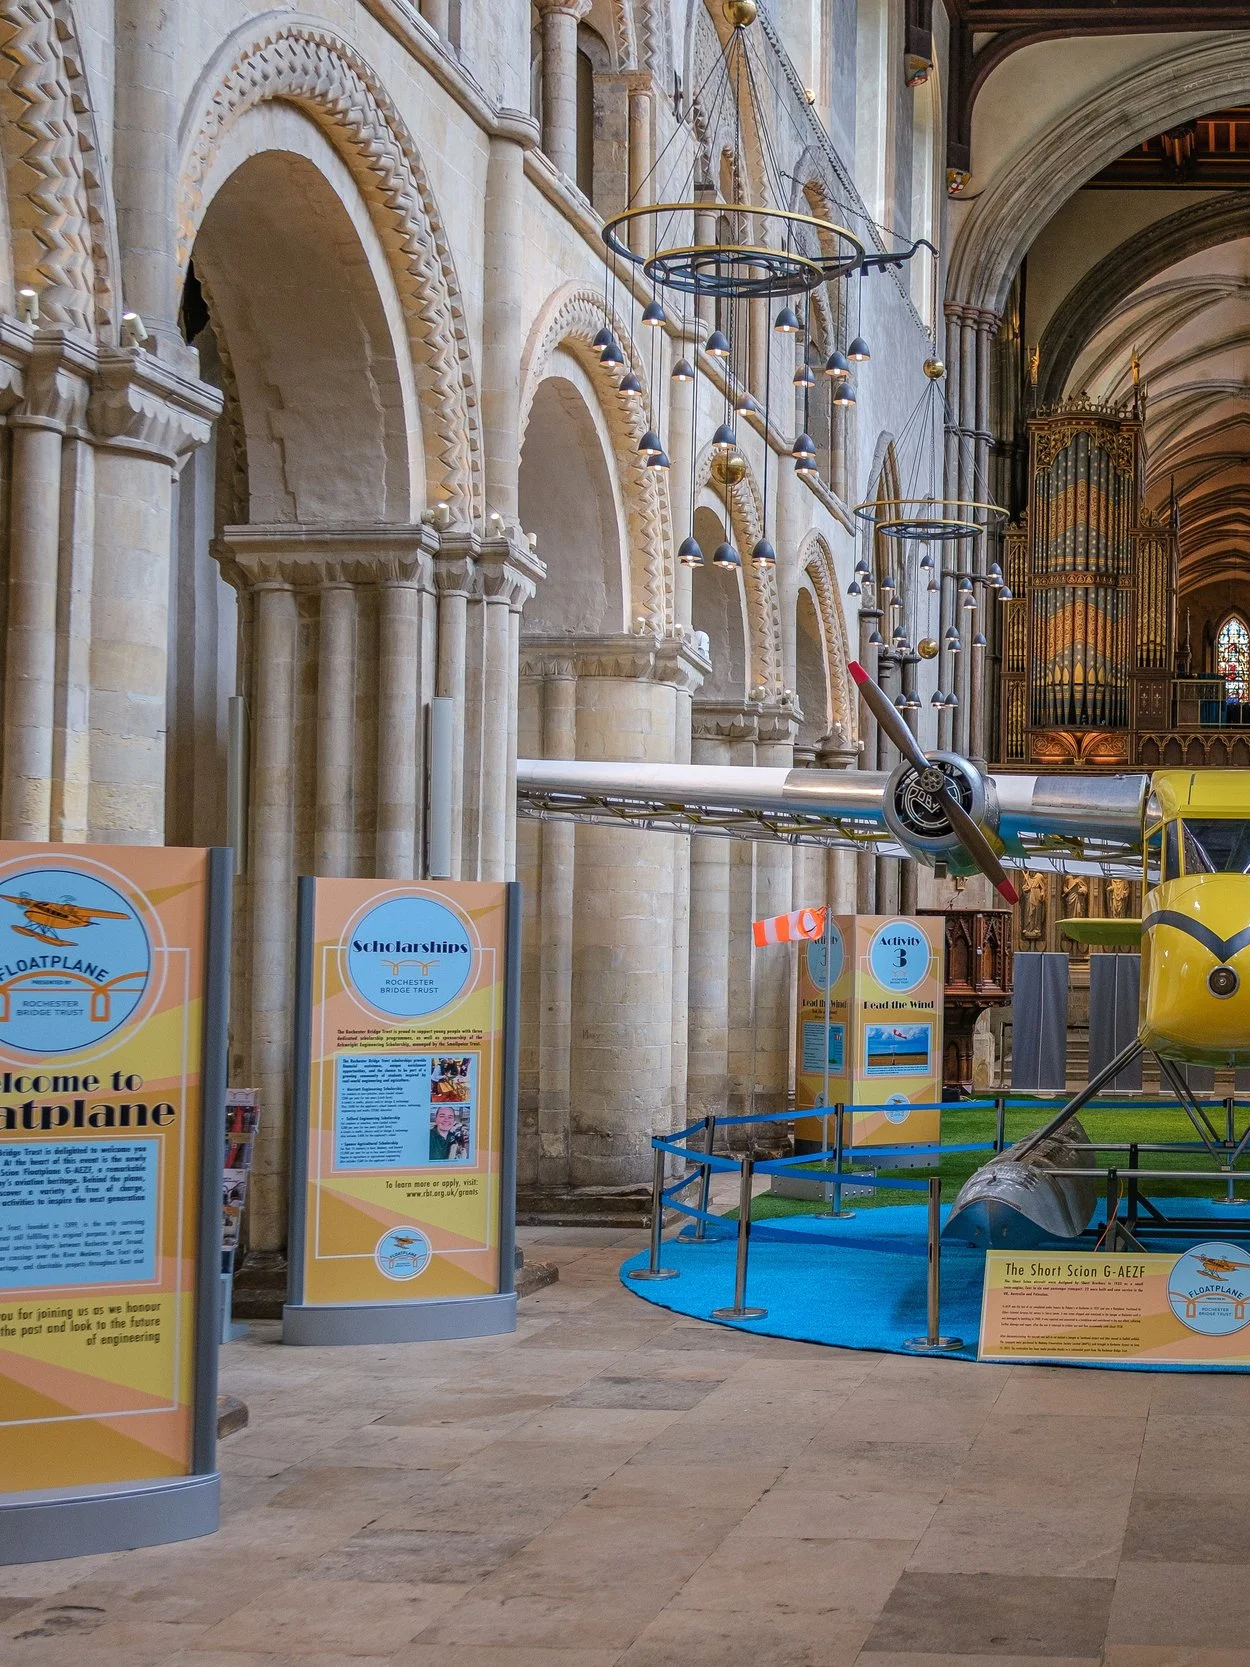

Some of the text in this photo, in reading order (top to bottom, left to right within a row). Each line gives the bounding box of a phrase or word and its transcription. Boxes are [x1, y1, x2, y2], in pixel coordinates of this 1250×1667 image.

[352, 940, 468, 954] Scholarships
[880, 936, 921, 946] Activity
[892, 948, 907, 967] 3
[864, 1001, 888, 1009] Read
[0, 1070, 143, 1093] lcome to
[395, 1180, 412, 1188] learn
[442, 1179, 461, 1189] apply,
[463, 1178, 478, 1186] visit:
[406, 1188, 479, 1198] www.rbt.org.uk/grants
[1005, 1262, 1146, 1278] The Short Scion G-AEZF
[1188, 1285, 1244, 1299] FLOATPLANE
[0, 1302, 161, 1321] ou for joining us as we honour
[0, 1316, 161, 1338] the past and look to the future
[86, 1331, 160, 1346] of engineering
